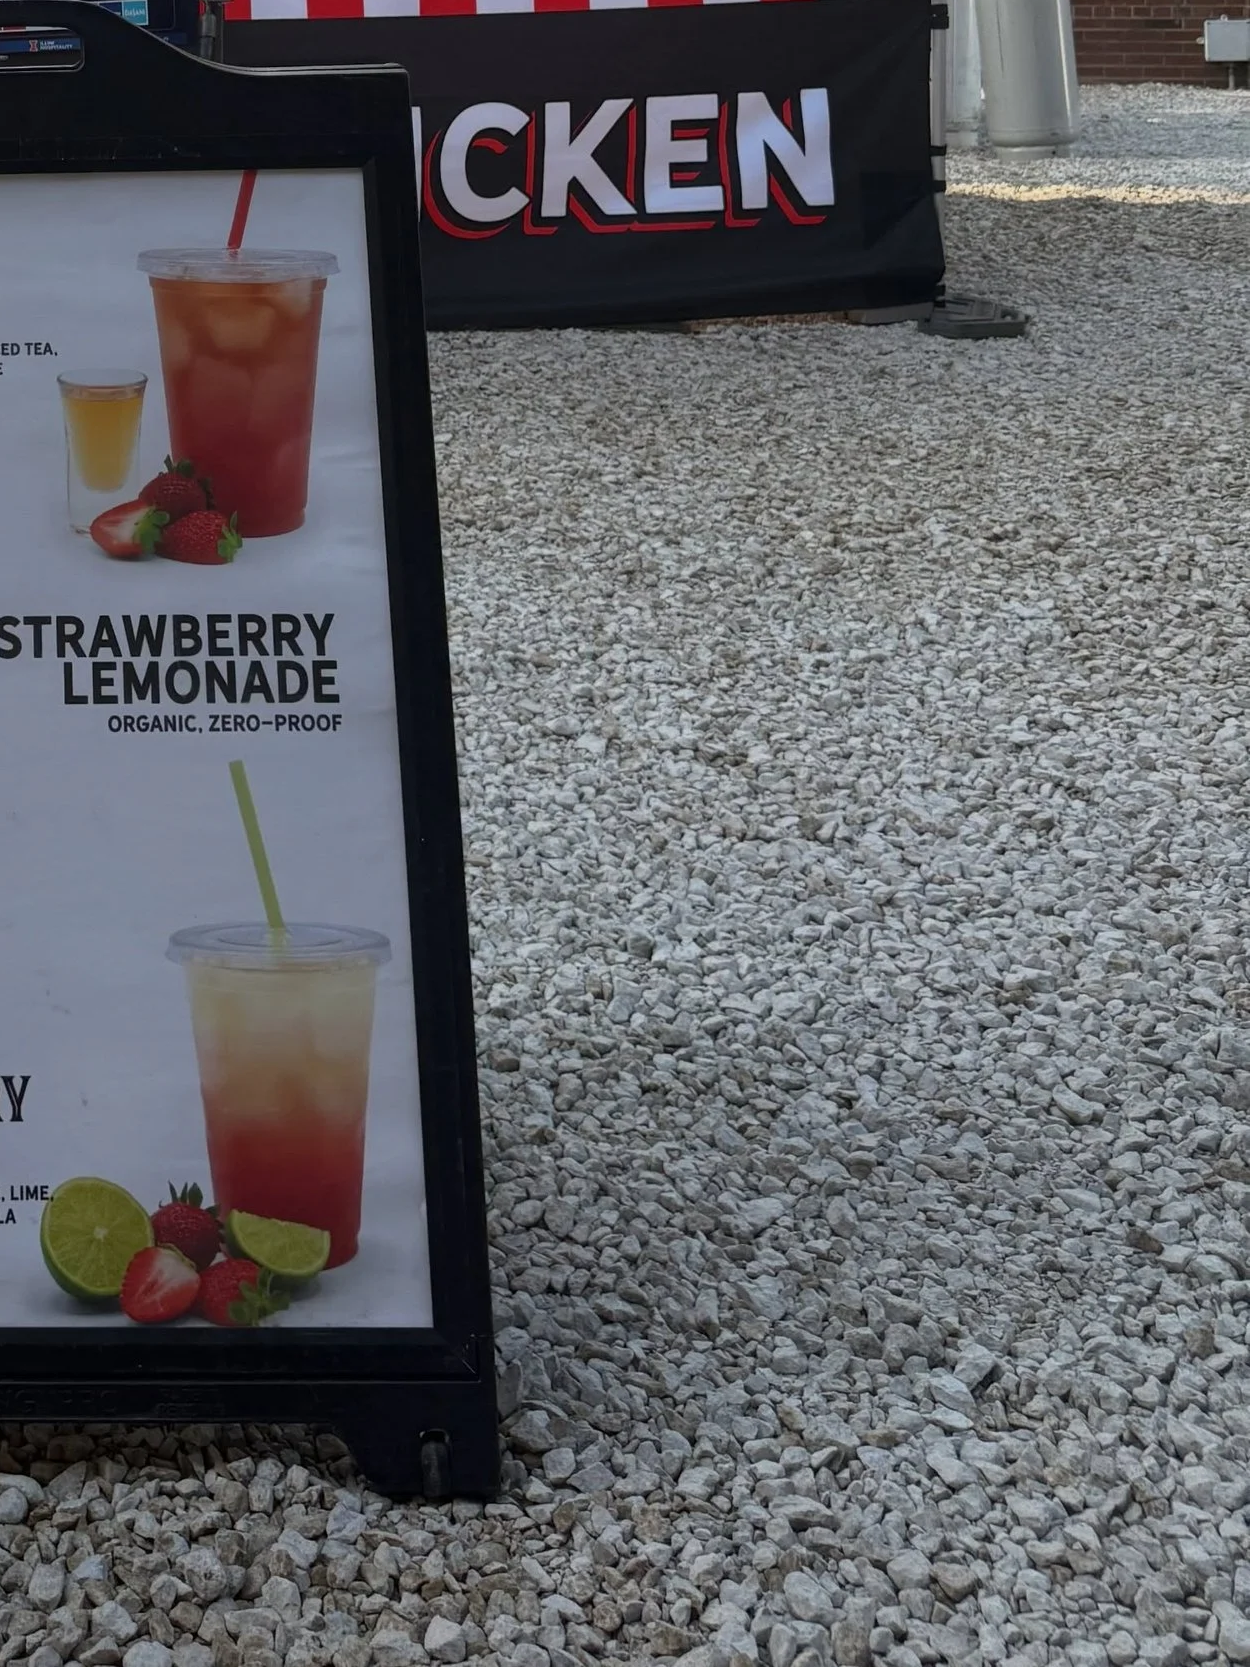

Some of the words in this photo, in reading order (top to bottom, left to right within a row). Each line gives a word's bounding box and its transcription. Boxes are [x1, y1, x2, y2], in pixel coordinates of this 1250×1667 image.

[413, 88, 835, 234] CKEN
[63, 660, 340, 705] LEMONADE
[108, 714, 204, 734] ORGANIC,
[208, 714, 342, 732] ZERO-PROOF
